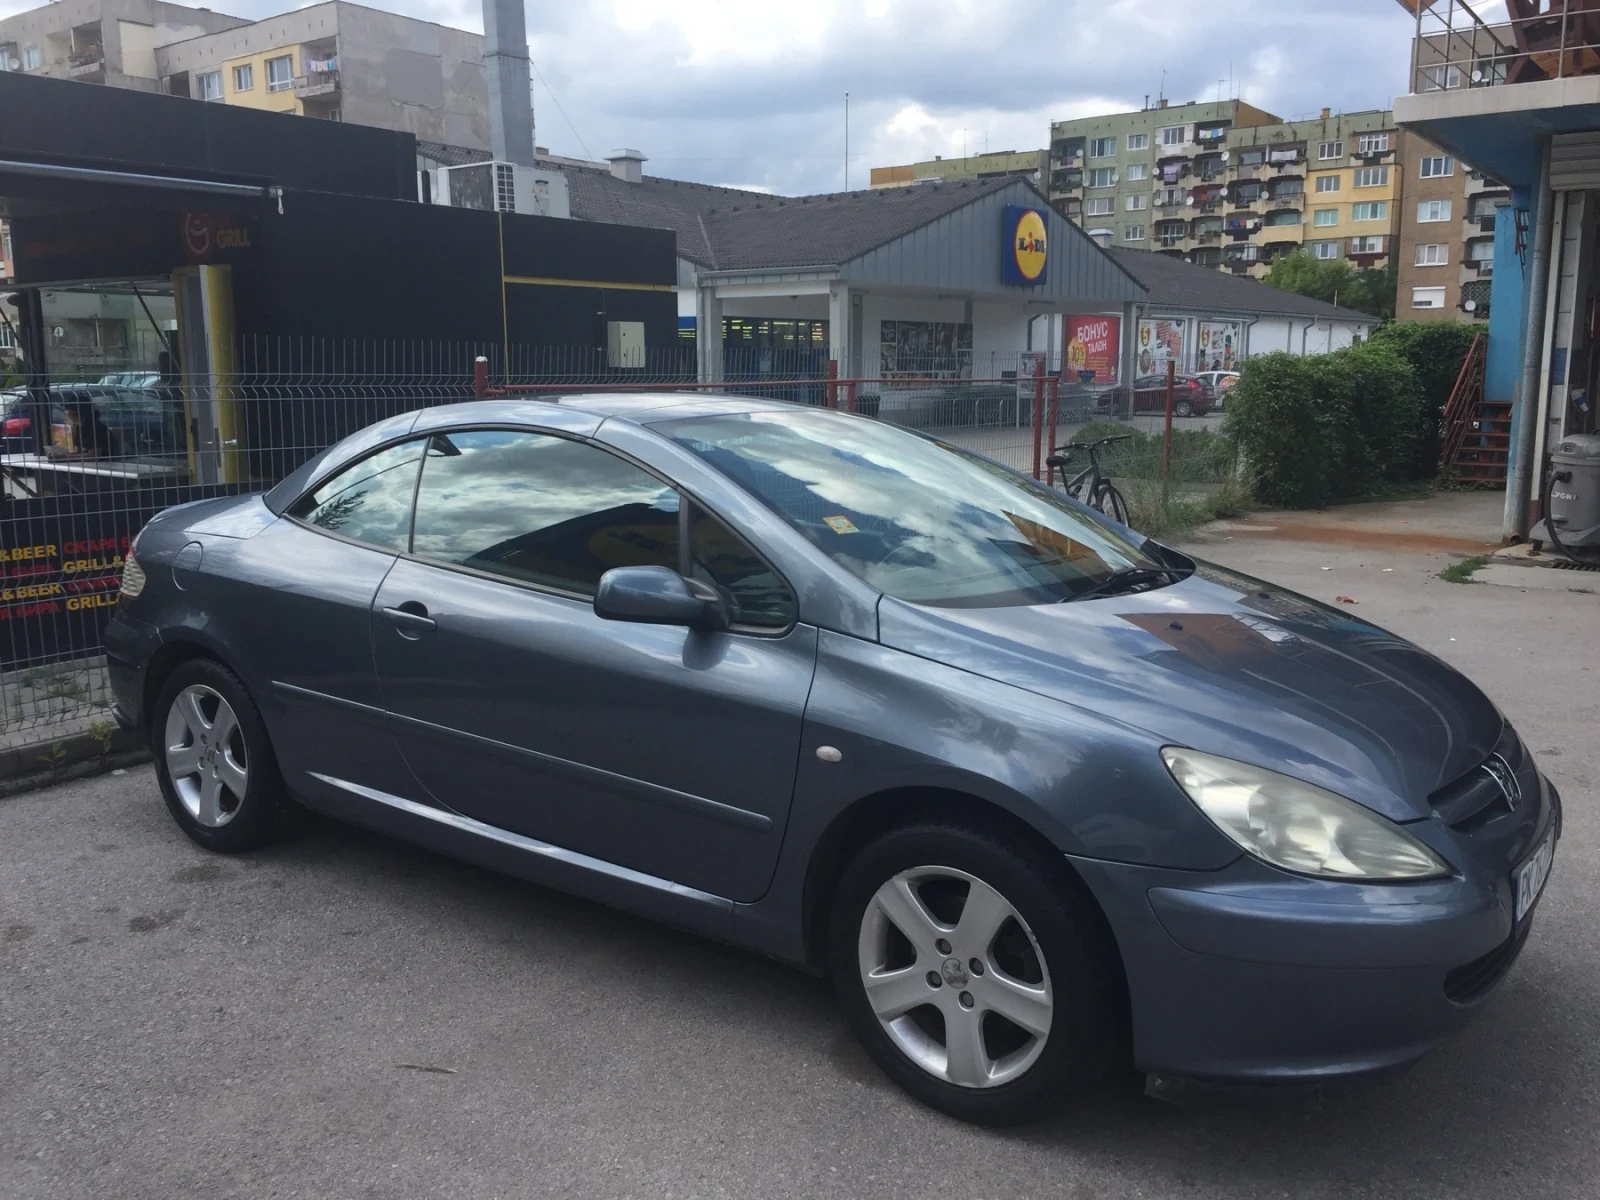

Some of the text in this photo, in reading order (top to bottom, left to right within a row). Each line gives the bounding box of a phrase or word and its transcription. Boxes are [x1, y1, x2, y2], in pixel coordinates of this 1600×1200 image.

[217, 228, 251, 248] GRILL
[1077, 321, 1108, 343] БОНУС
[1088, 340, 1107, 354] ТАЛОН
[16, 602, 60, 618] БИРА
